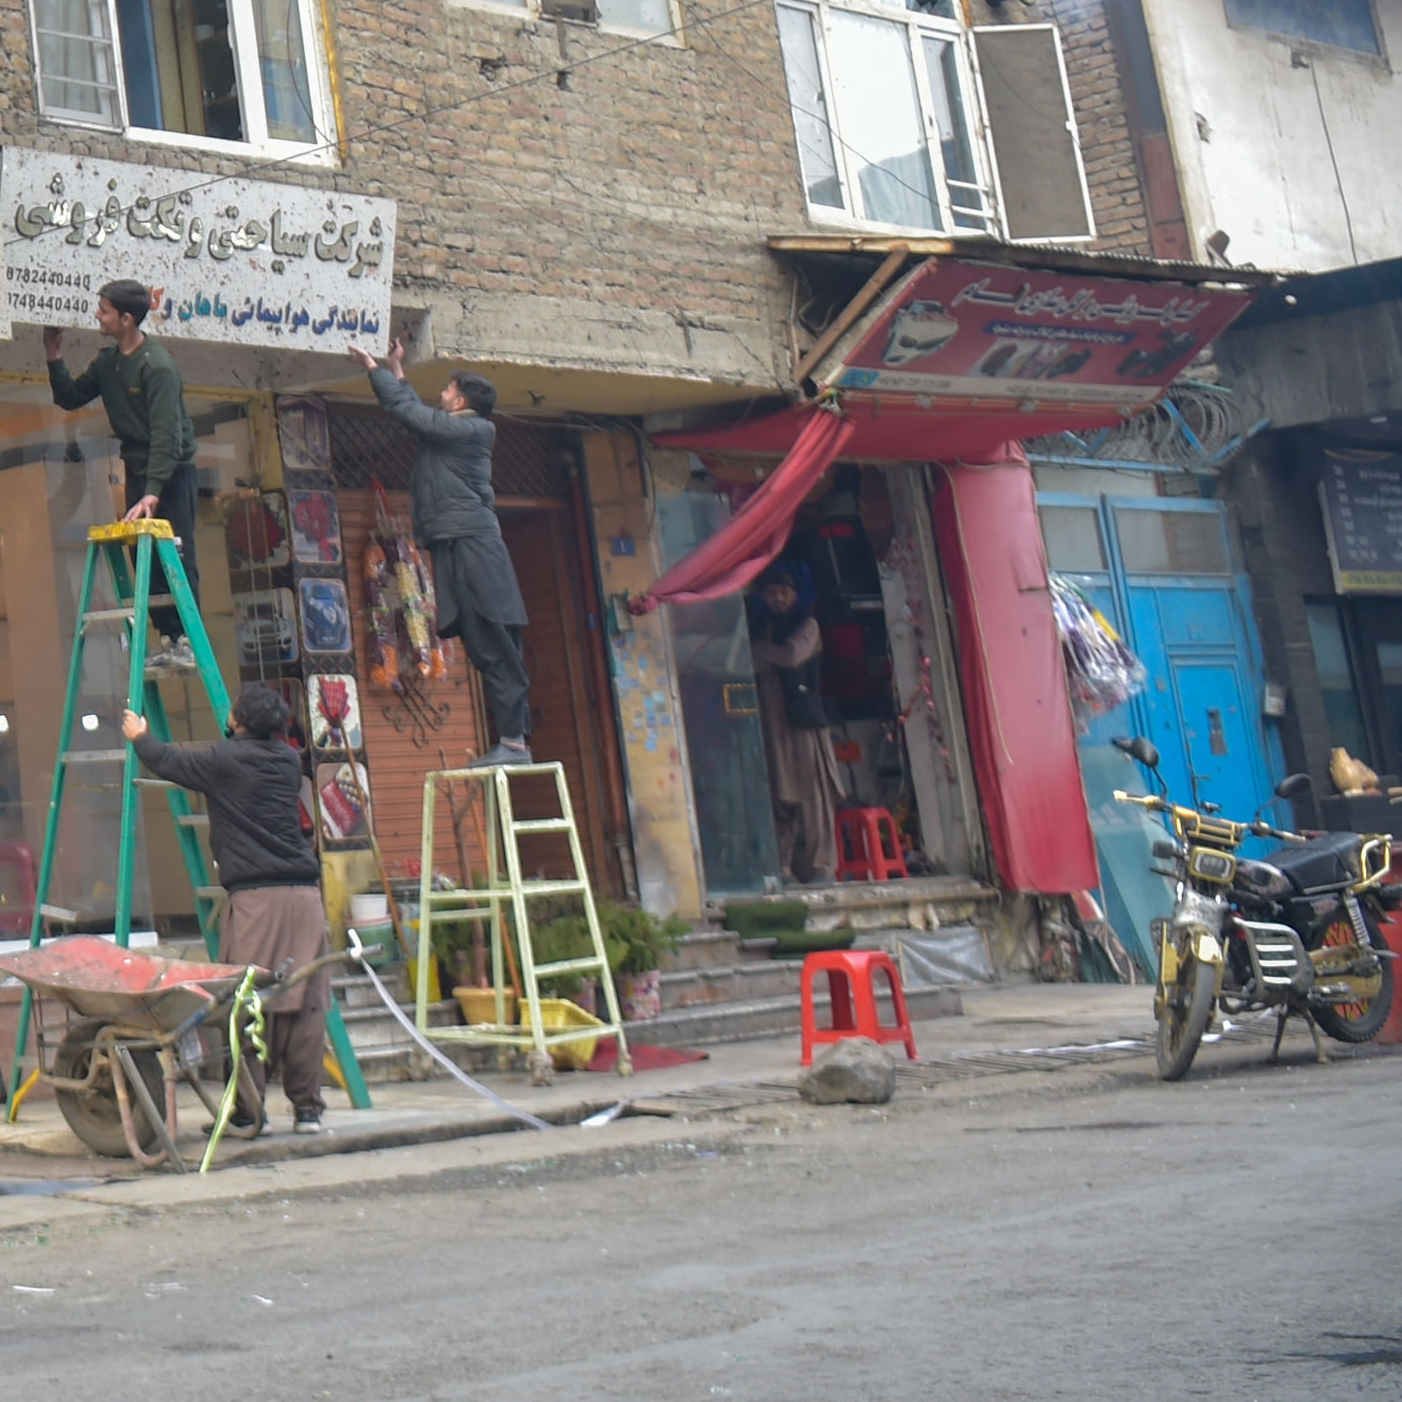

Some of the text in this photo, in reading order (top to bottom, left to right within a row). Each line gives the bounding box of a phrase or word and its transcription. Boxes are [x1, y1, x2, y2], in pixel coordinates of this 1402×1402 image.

[15, 171, 384, 279] شرکت سیاحتی و تکت فروشی
[5, 266, 91, 292] 0782440440
[160, 297, 173, 320] و
[177, 290, 228, 322] ماهان
[311, 304, 380, 337] نمایندگی
